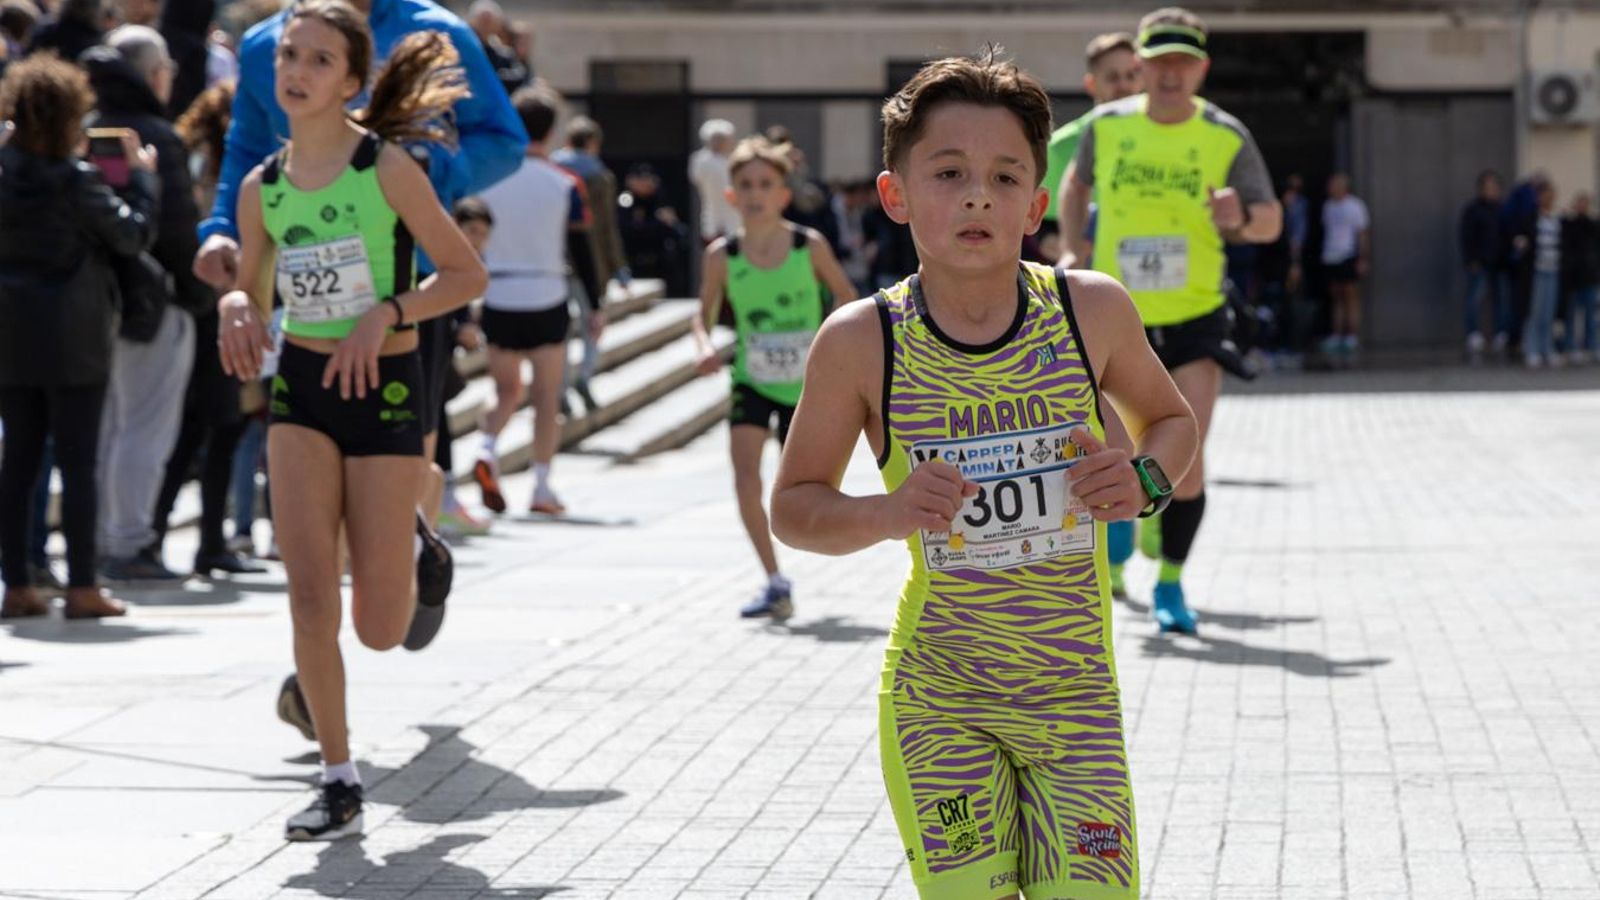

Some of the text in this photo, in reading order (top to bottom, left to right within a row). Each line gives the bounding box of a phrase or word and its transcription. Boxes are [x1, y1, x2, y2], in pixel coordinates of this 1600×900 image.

[292, 268, 342, 299] 522
[949, 394, 1050, 438] MARIO
[962, 474, 1047, 528] 301
[937, 794, 969, 827] CR7
[1078, 825, 1119, 845] Santo
